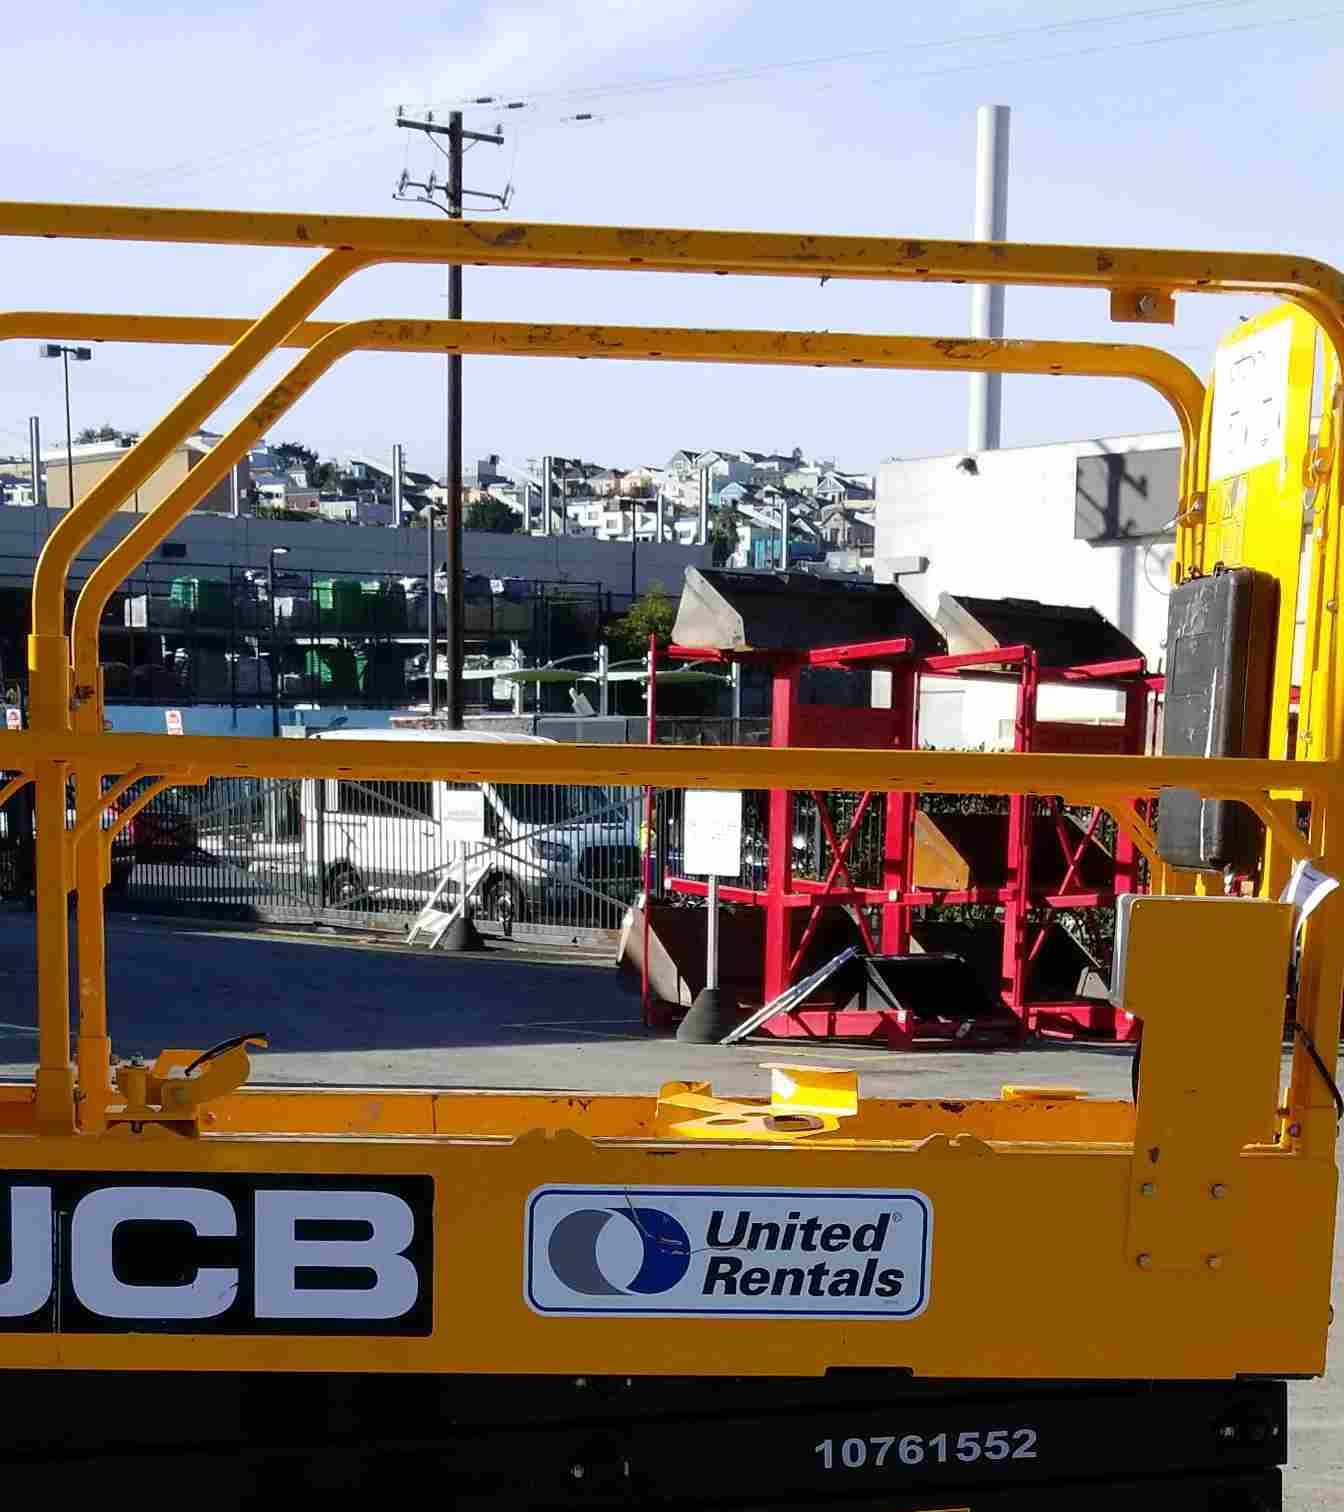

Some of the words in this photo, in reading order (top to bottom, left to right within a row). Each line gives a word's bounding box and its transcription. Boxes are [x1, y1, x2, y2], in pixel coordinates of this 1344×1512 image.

[704, 1210, 891, 1253] United
[702, 1255, 905, 1297] Rentals
[815, 1428, 1038, 1469] 10761552
